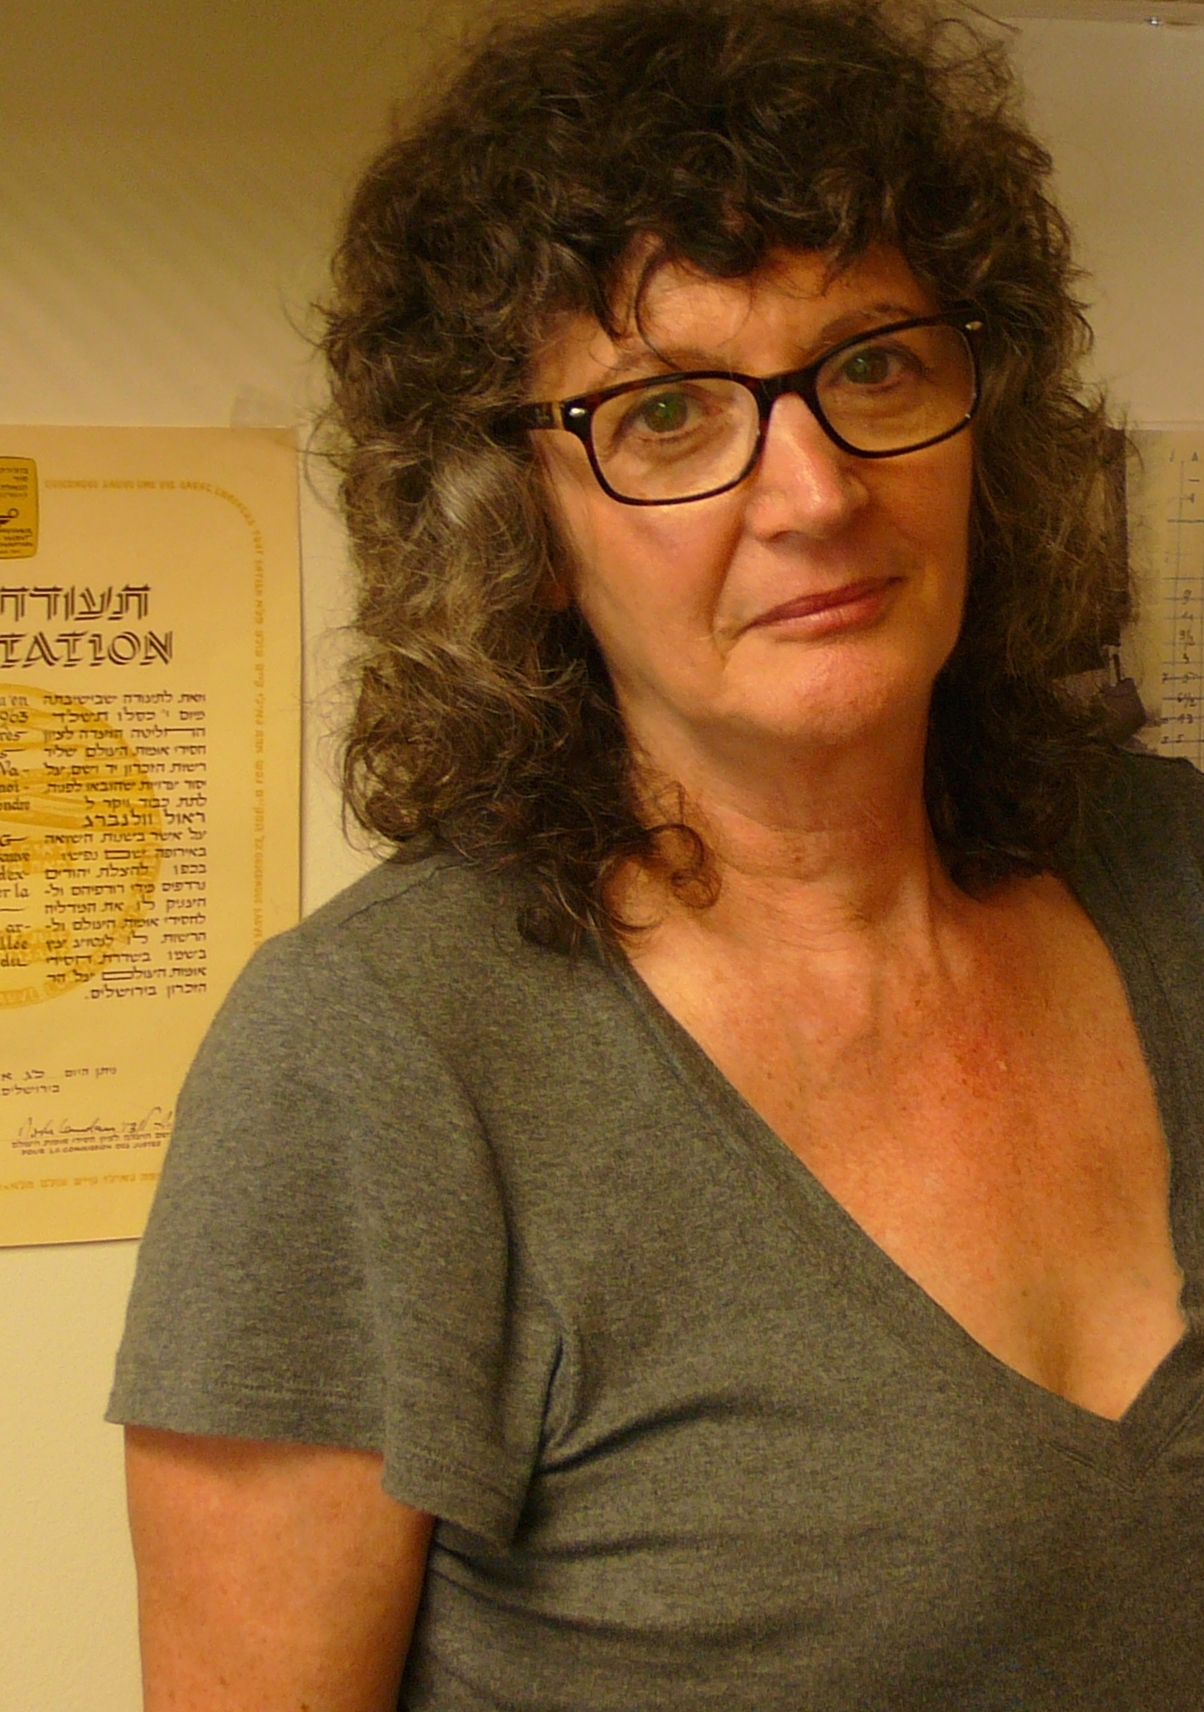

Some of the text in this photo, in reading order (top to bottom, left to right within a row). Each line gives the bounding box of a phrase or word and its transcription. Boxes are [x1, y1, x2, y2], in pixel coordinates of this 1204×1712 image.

[0, 583, 151, 622] תעודה
[82, 808, 206, 829] ראול וולנברג
